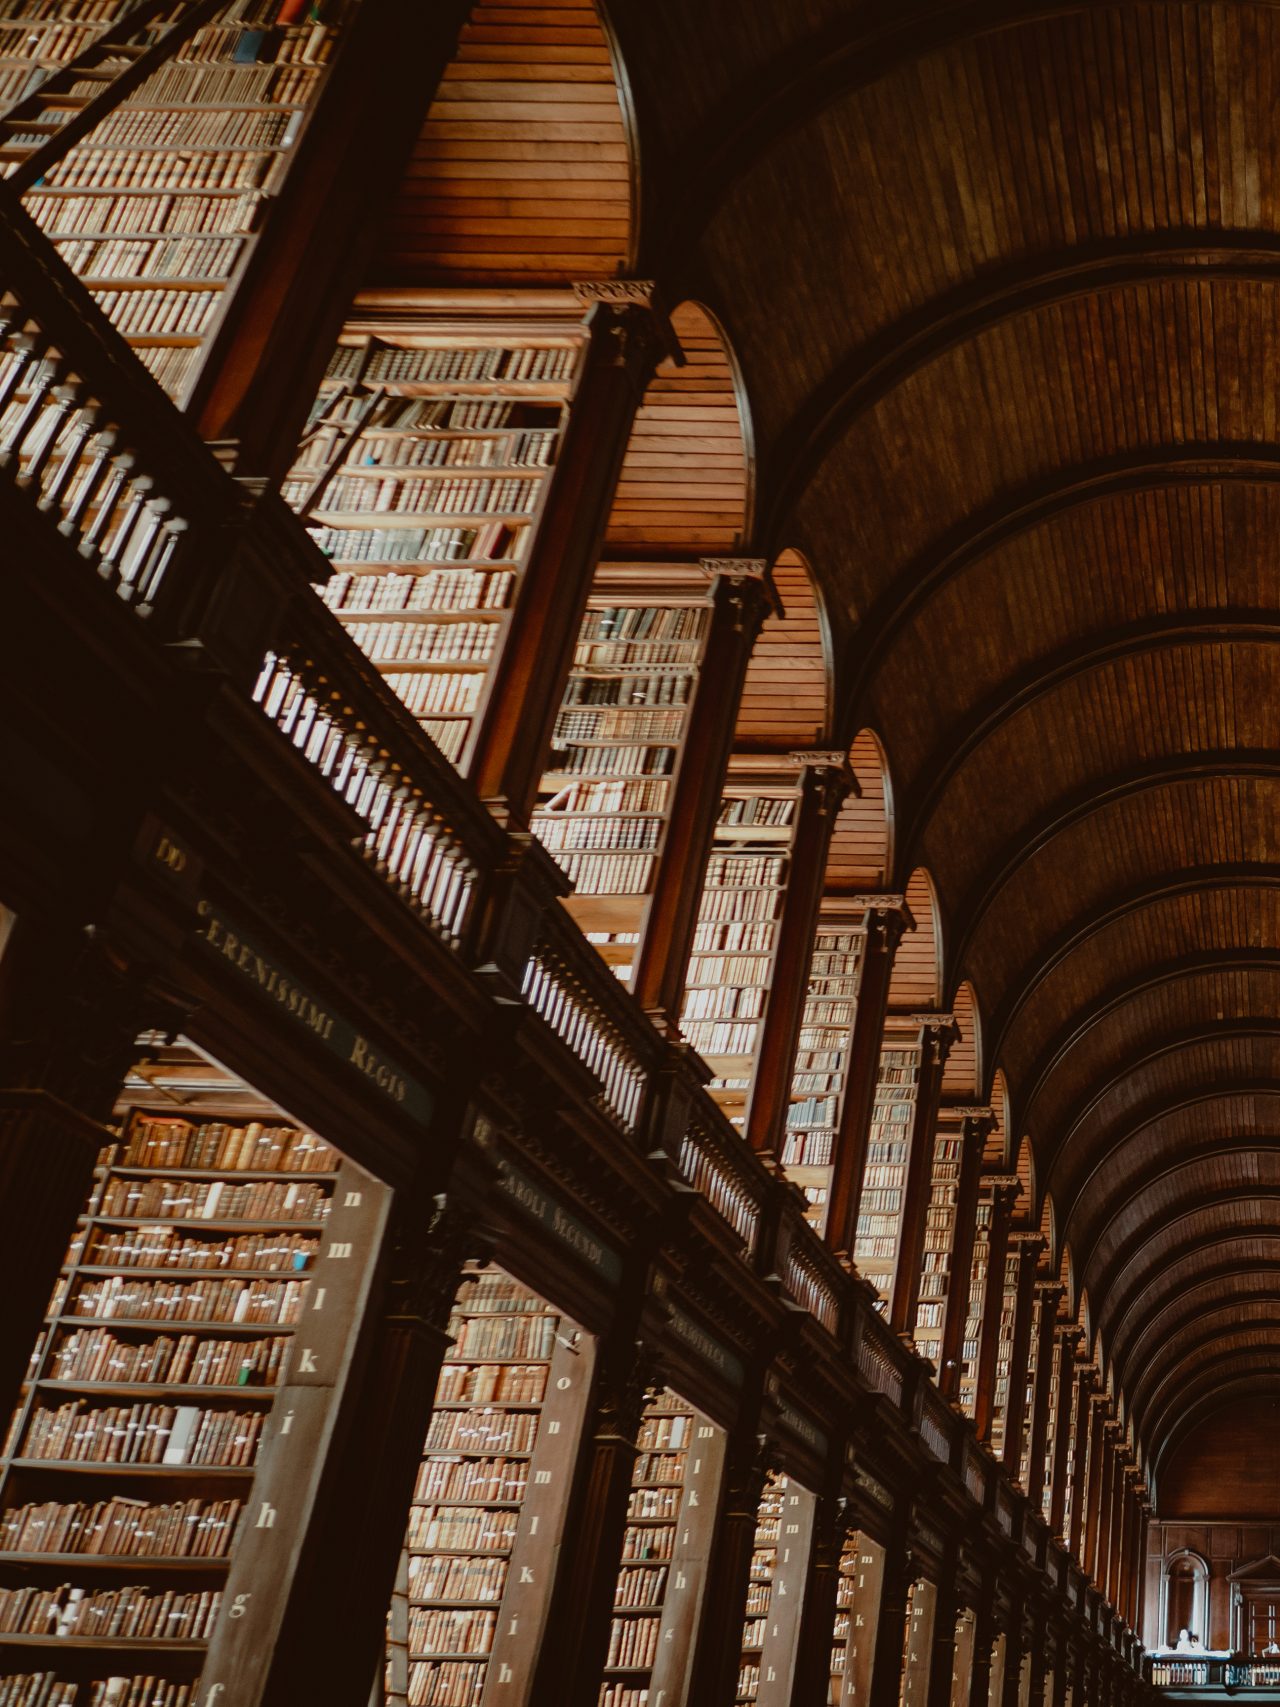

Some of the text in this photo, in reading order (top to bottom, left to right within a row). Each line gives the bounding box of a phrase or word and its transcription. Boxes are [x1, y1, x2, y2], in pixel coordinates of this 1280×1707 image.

[344, 1192, 361, 1206] n
[327, 1243, 352, 1258] m
[313, 1288, 326, 1309] l
[299, 1349, 318, 1372] k
[557, 1377, 570, 1389] o
[280, 1410, 294, 1434] i
[548, 1421, 560, 1434] n
[698, 1427, 713, 1438] m
[535, 1471, 551, 1483] m
[688, 1490, 700, 1506] k
[789, 1496, 798, 1505] n
[255, 1502, 276, 1527] h
[530, 1517, 539, 1534] l
[786, 1525, 798, 1533] m
[518, 1566, 536, 1583] k
[675, 1572, 685, 1589] h
[778, 1581, 786, 1595] k
[229, 1594, 251, 1618] g
[508, 1614, 517, 1635] i
[856, 1615, 864, 1626] k
[664, 1628, 674, 1643] g
[498, 1663, 512, 1682] h
[767, 1667, 775, 1681] h
[847, 1682, 855, 1695] h
